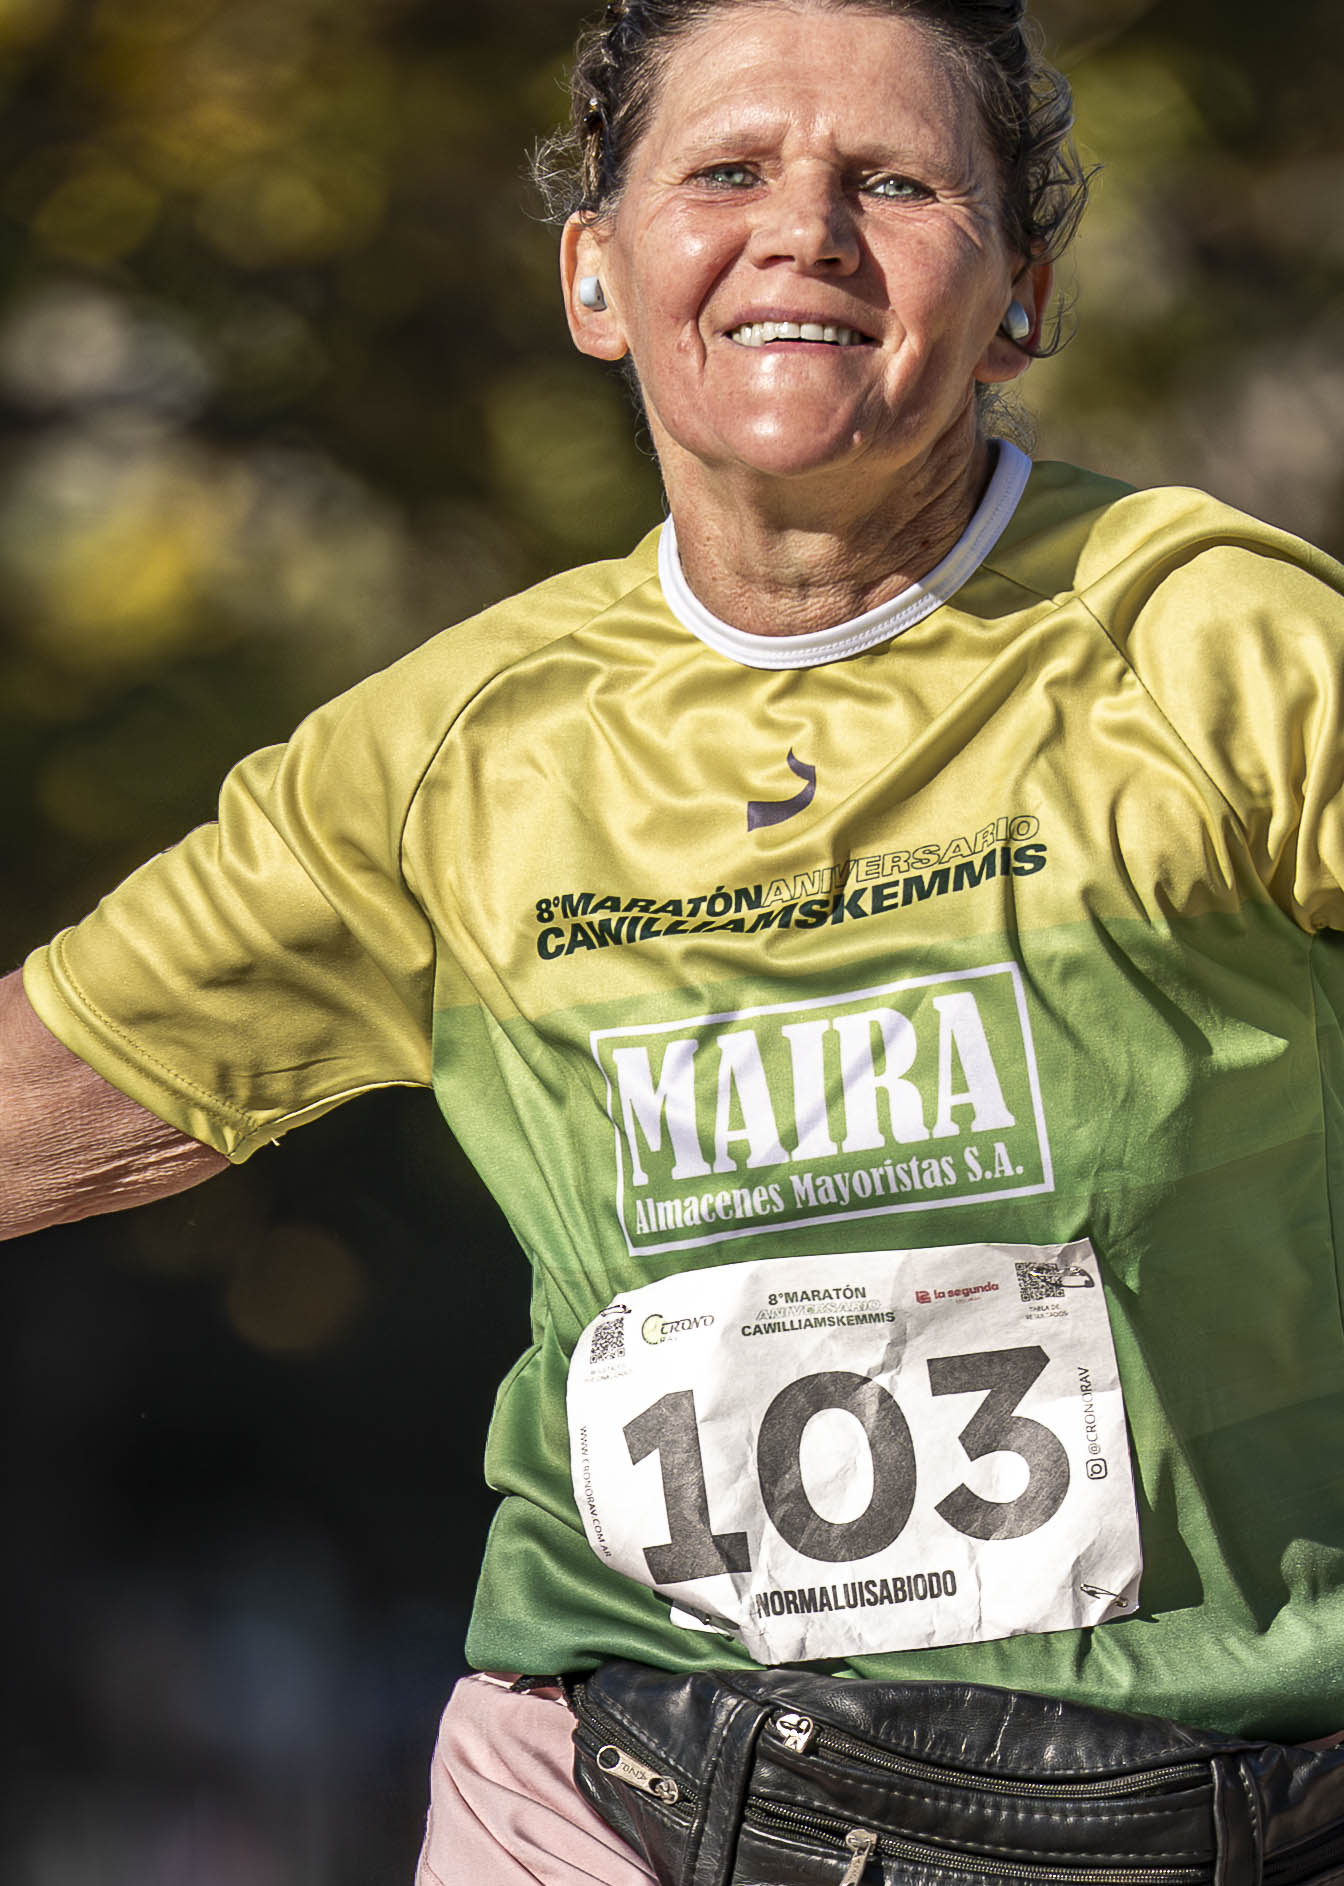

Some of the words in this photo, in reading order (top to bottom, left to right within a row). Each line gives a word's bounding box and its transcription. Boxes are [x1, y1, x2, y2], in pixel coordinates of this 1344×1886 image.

[537, 843, 1047, 960] CAWILLIAMSKEMMIS
[612, 991, 1016, 1187] MAIRA
[636, 1182, 785, 1235] Almacenes
[789, 1154, 956, 1209] Mayoristas
[963, 1141, 1025, 1183] S.A.
[741, 1311, 896, 1337] CAWILLIAMSKEMMIS
[933, 1289, 946, 1300] la
[947, 1281, 999, 1298] segunda
[1077, 1366, 1102, 1456] @CRONORAV
[622, 1345, 1071, 1584] 103
[755, 1569, 957, 1619] NORMALUISABIODO
